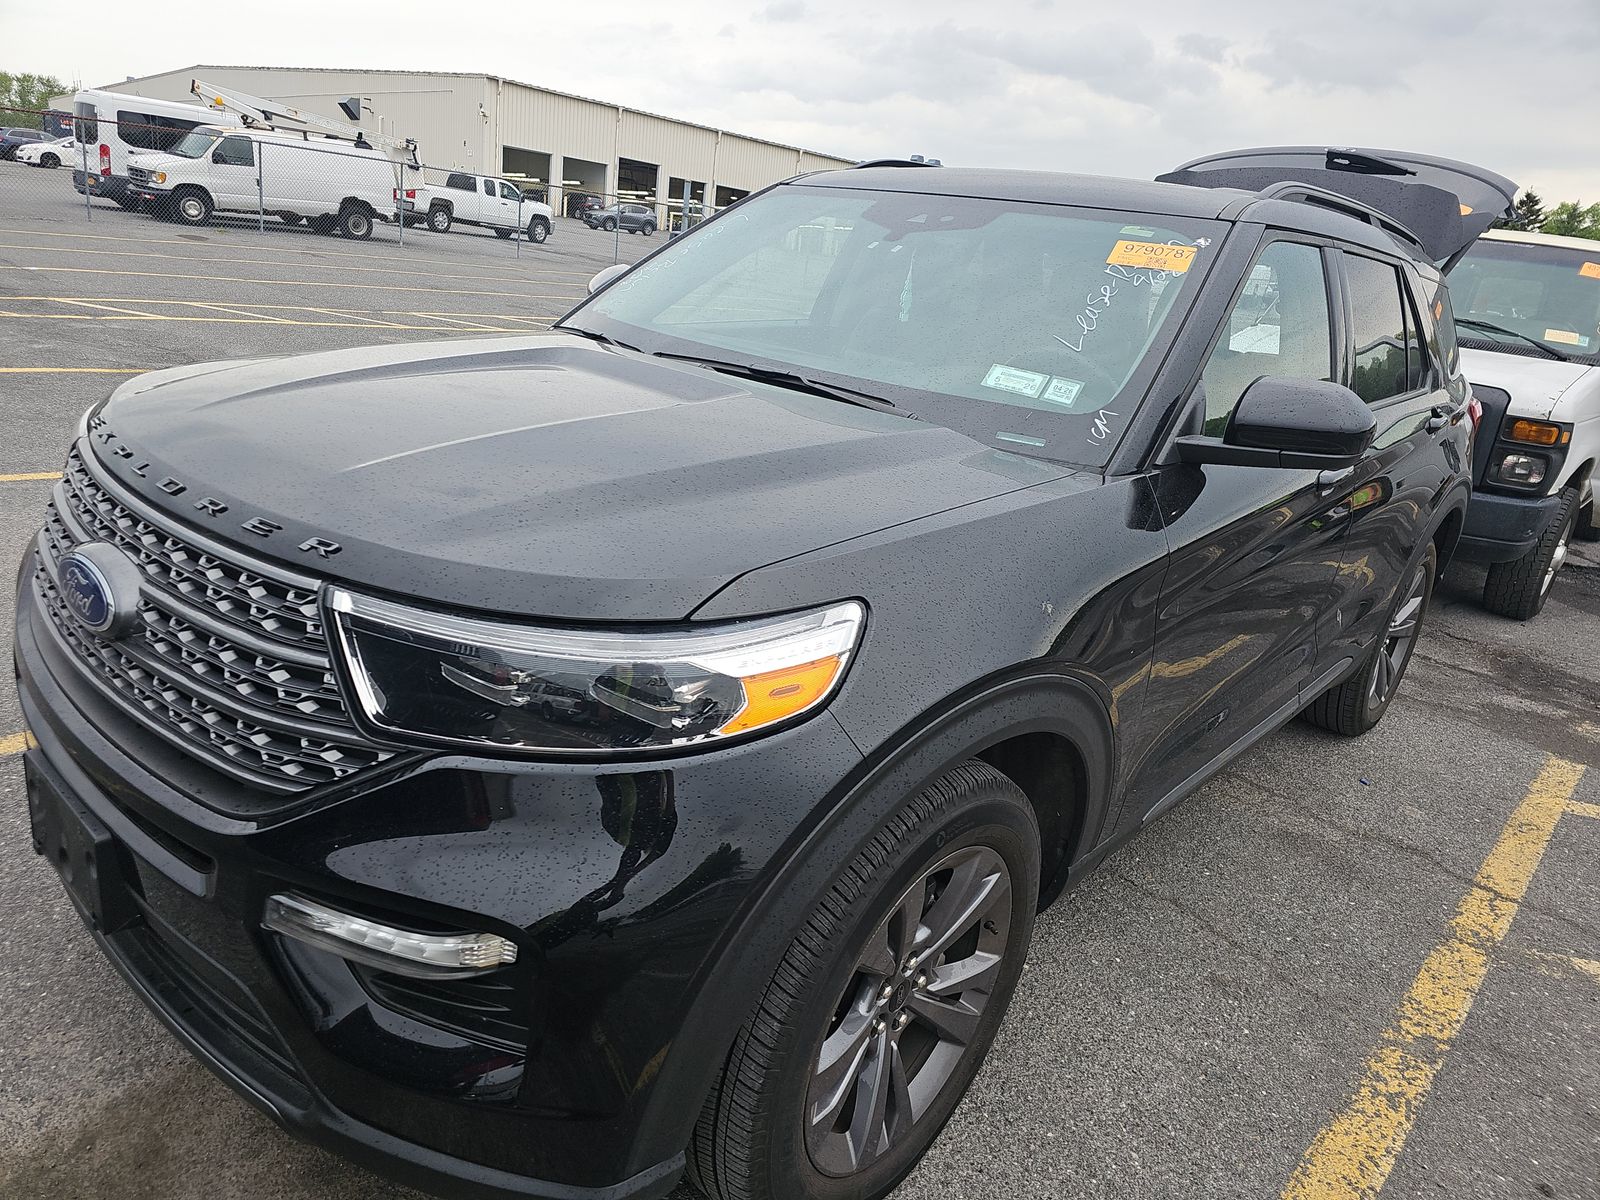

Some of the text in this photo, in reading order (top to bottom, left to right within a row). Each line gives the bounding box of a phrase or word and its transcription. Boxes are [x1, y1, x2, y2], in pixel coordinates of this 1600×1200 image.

[1123, 243, 1197, 260] 9790787
[90, 414, 344, 559] EXPLORER
[63, 566, 96, 616] Ford
